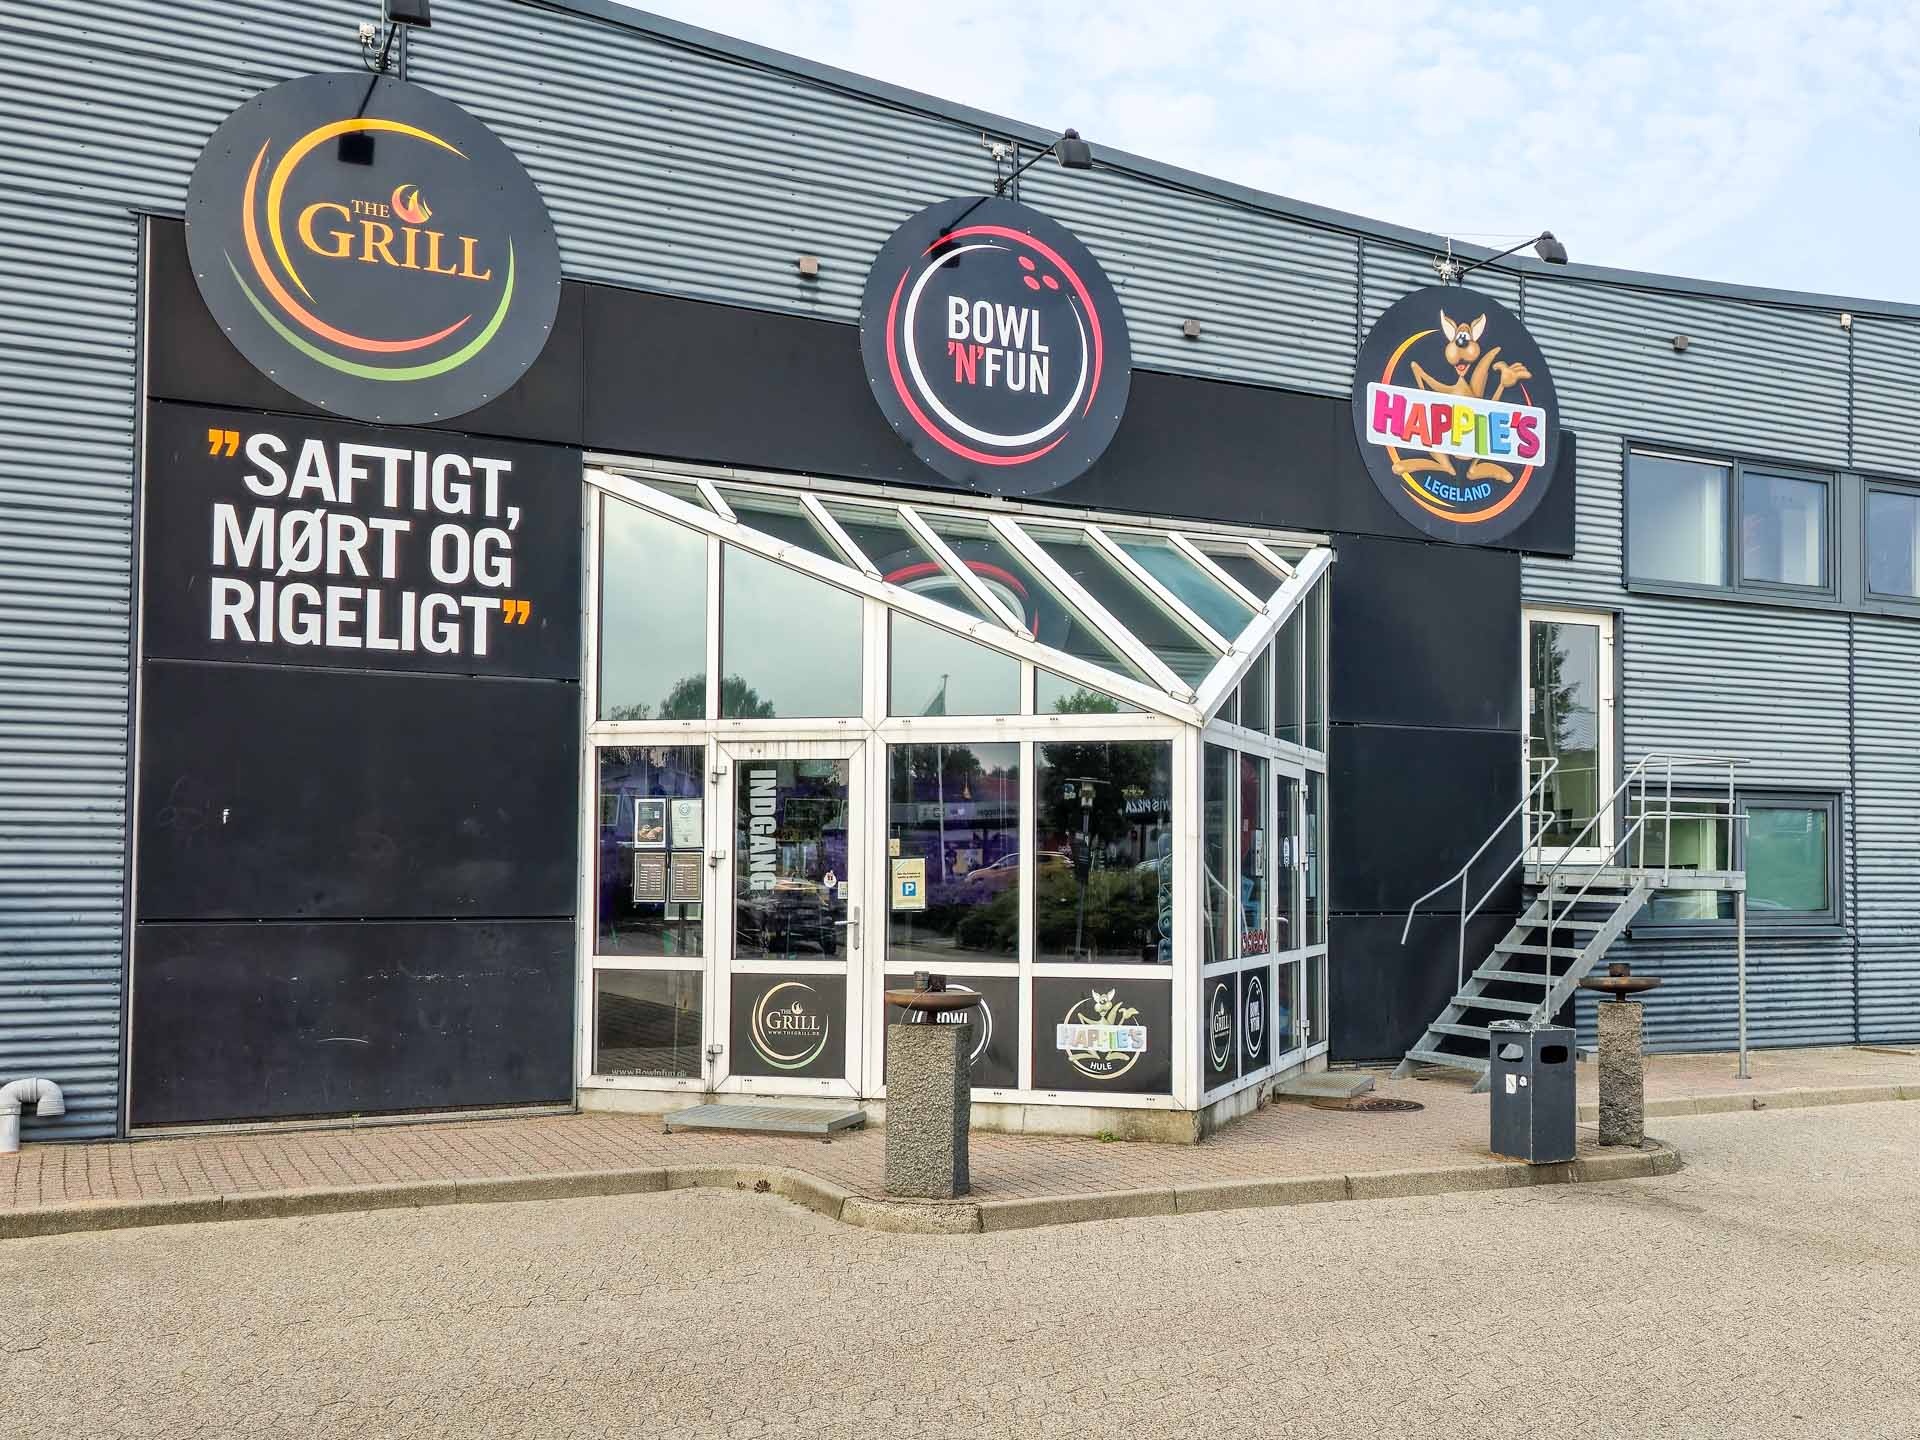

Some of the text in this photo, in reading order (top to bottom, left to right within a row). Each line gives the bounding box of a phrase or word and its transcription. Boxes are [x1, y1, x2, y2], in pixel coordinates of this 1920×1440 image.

[352, 200, 390, 218] THE
[298, 202, 491, 280] GRILL
[948, 295, 1049, 353] BOWL
[1372, 389, 1541, 459] HAPPIE'S
[1424, 475, 1492, 502] LEGELAND
[212, 503, 512, 588] MØRT OG
[749, 769, 777, 891] INDGANG
[766, 1011, 820, 1030] GRILL
[1090, 1061, 1113, 1071] HULE
